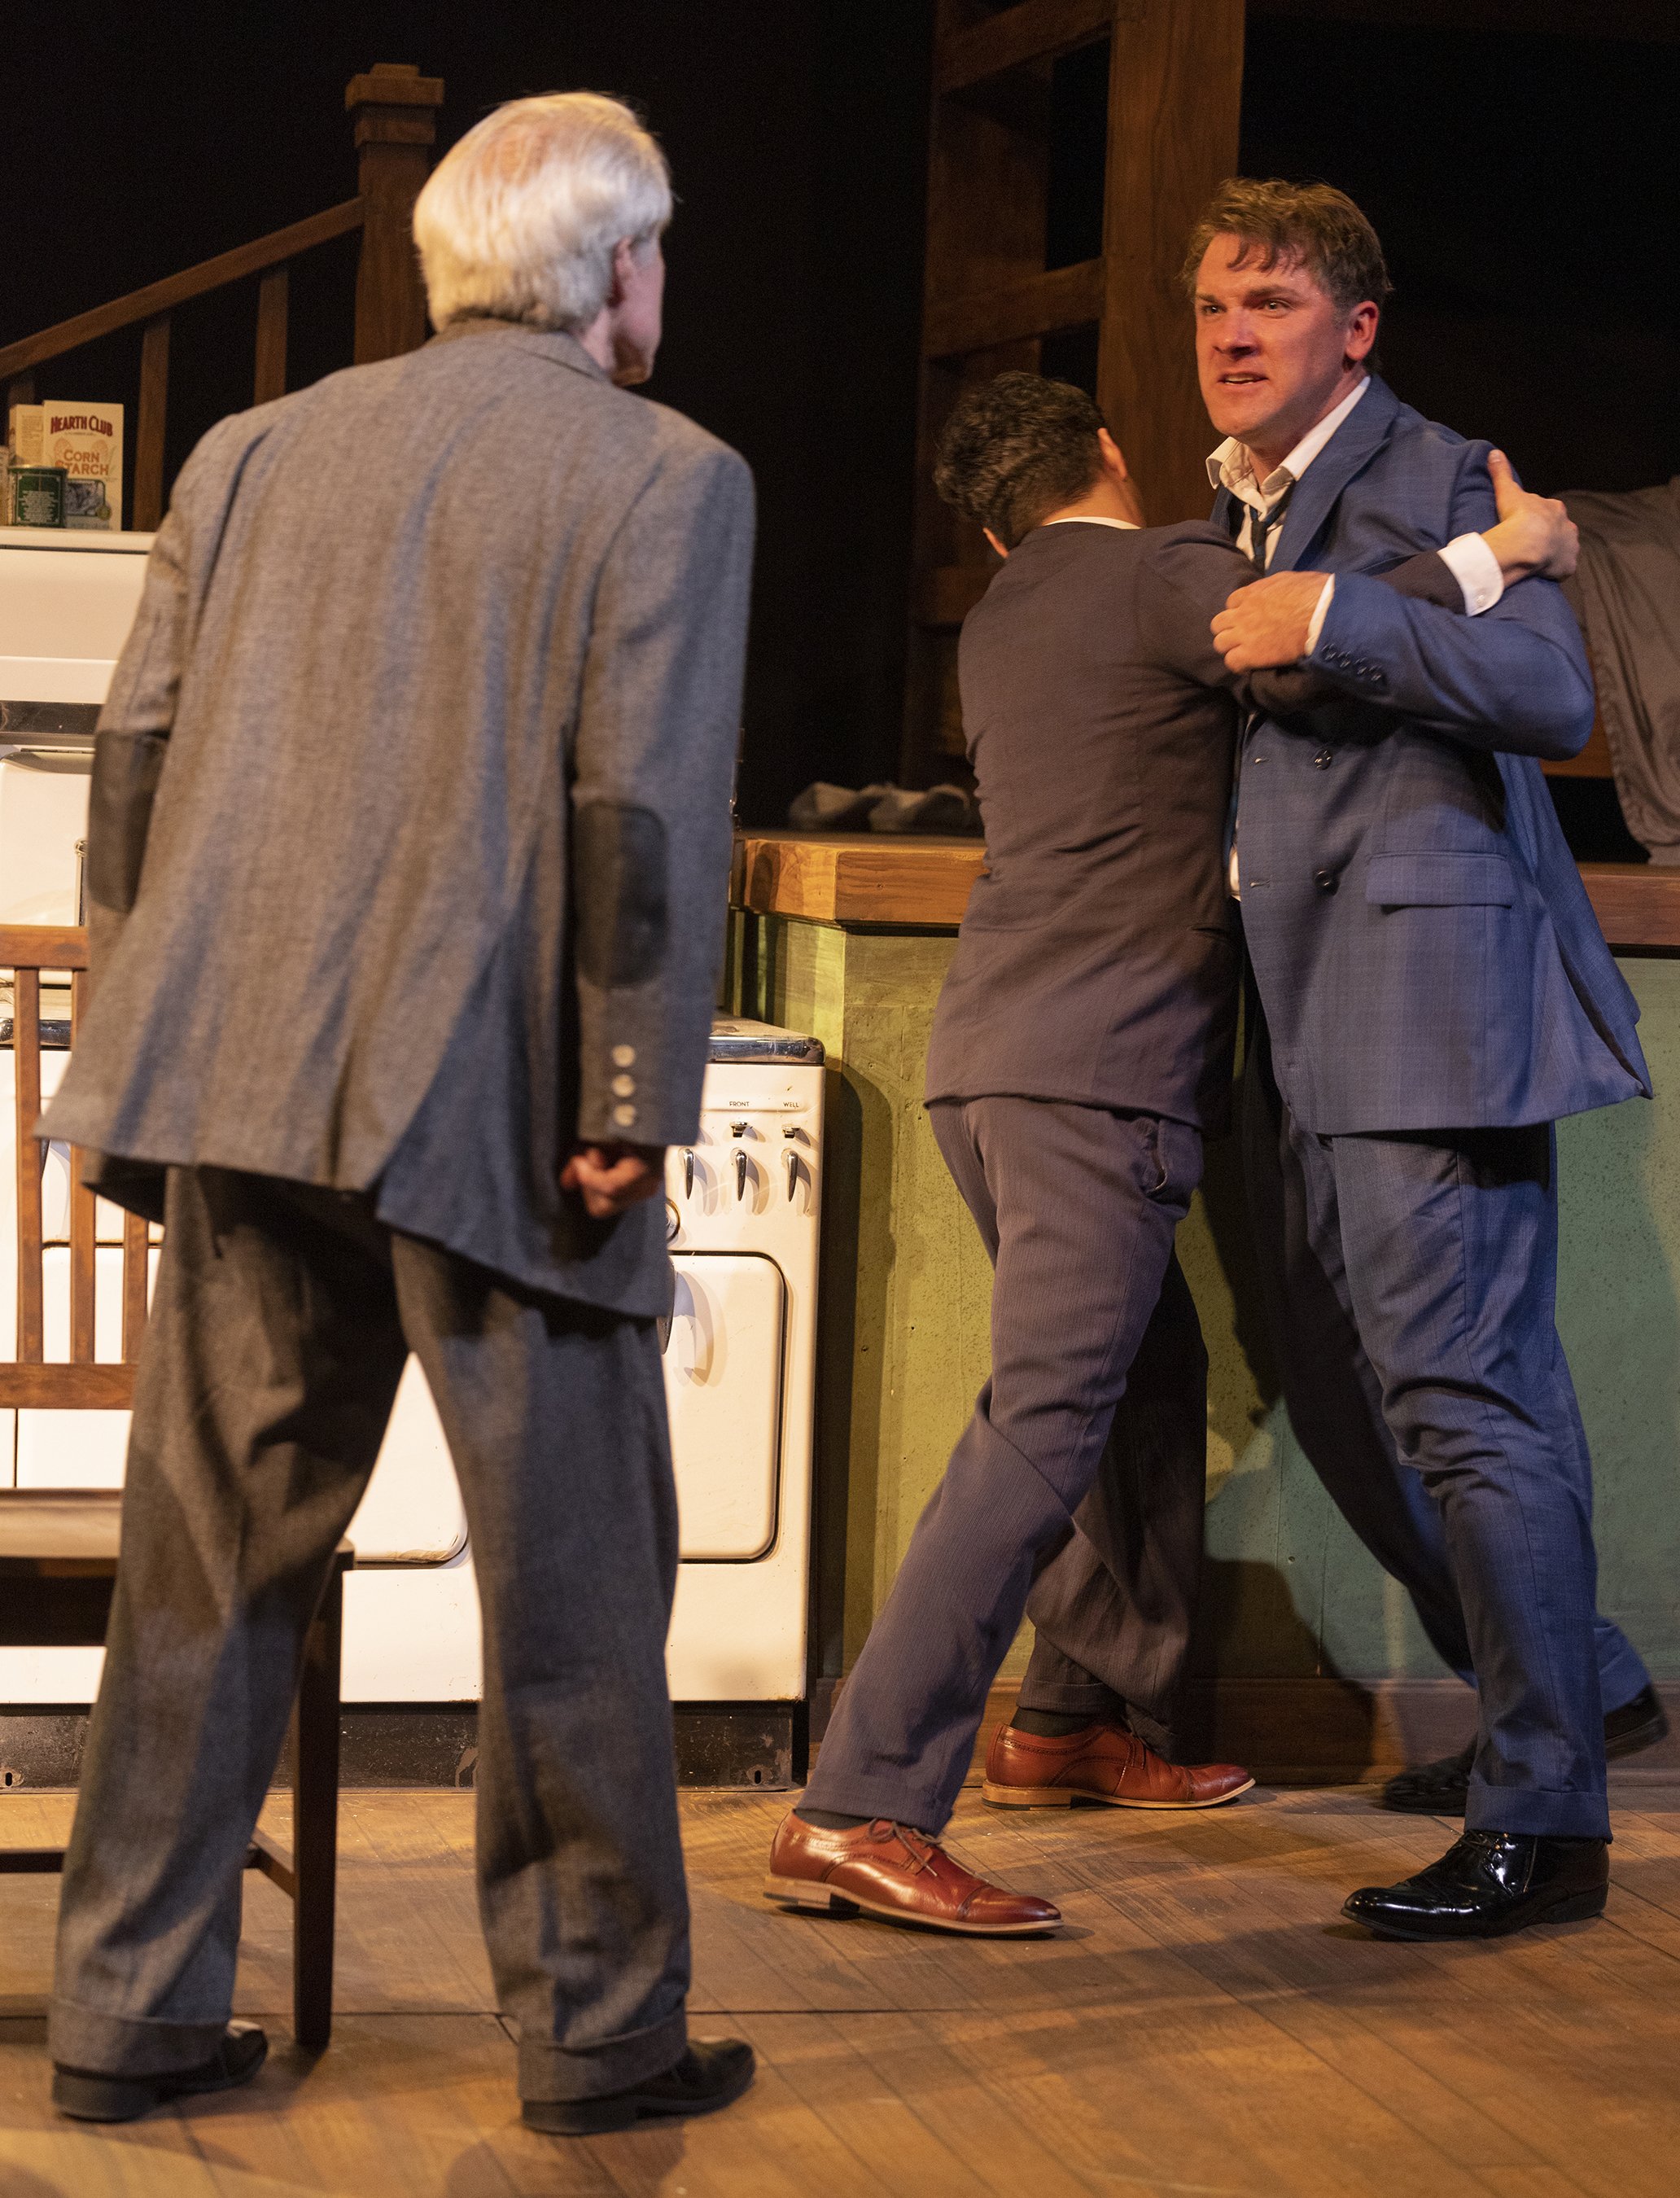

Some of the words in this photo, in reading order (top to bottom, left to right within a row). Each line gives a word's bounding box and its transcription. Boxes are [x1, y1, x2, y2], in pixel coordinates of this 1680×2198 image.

[50, 416, 87, 434] HEARTH
[89, 415, 113, 436] CLUB
[63, 449, 99, 462] CORN
